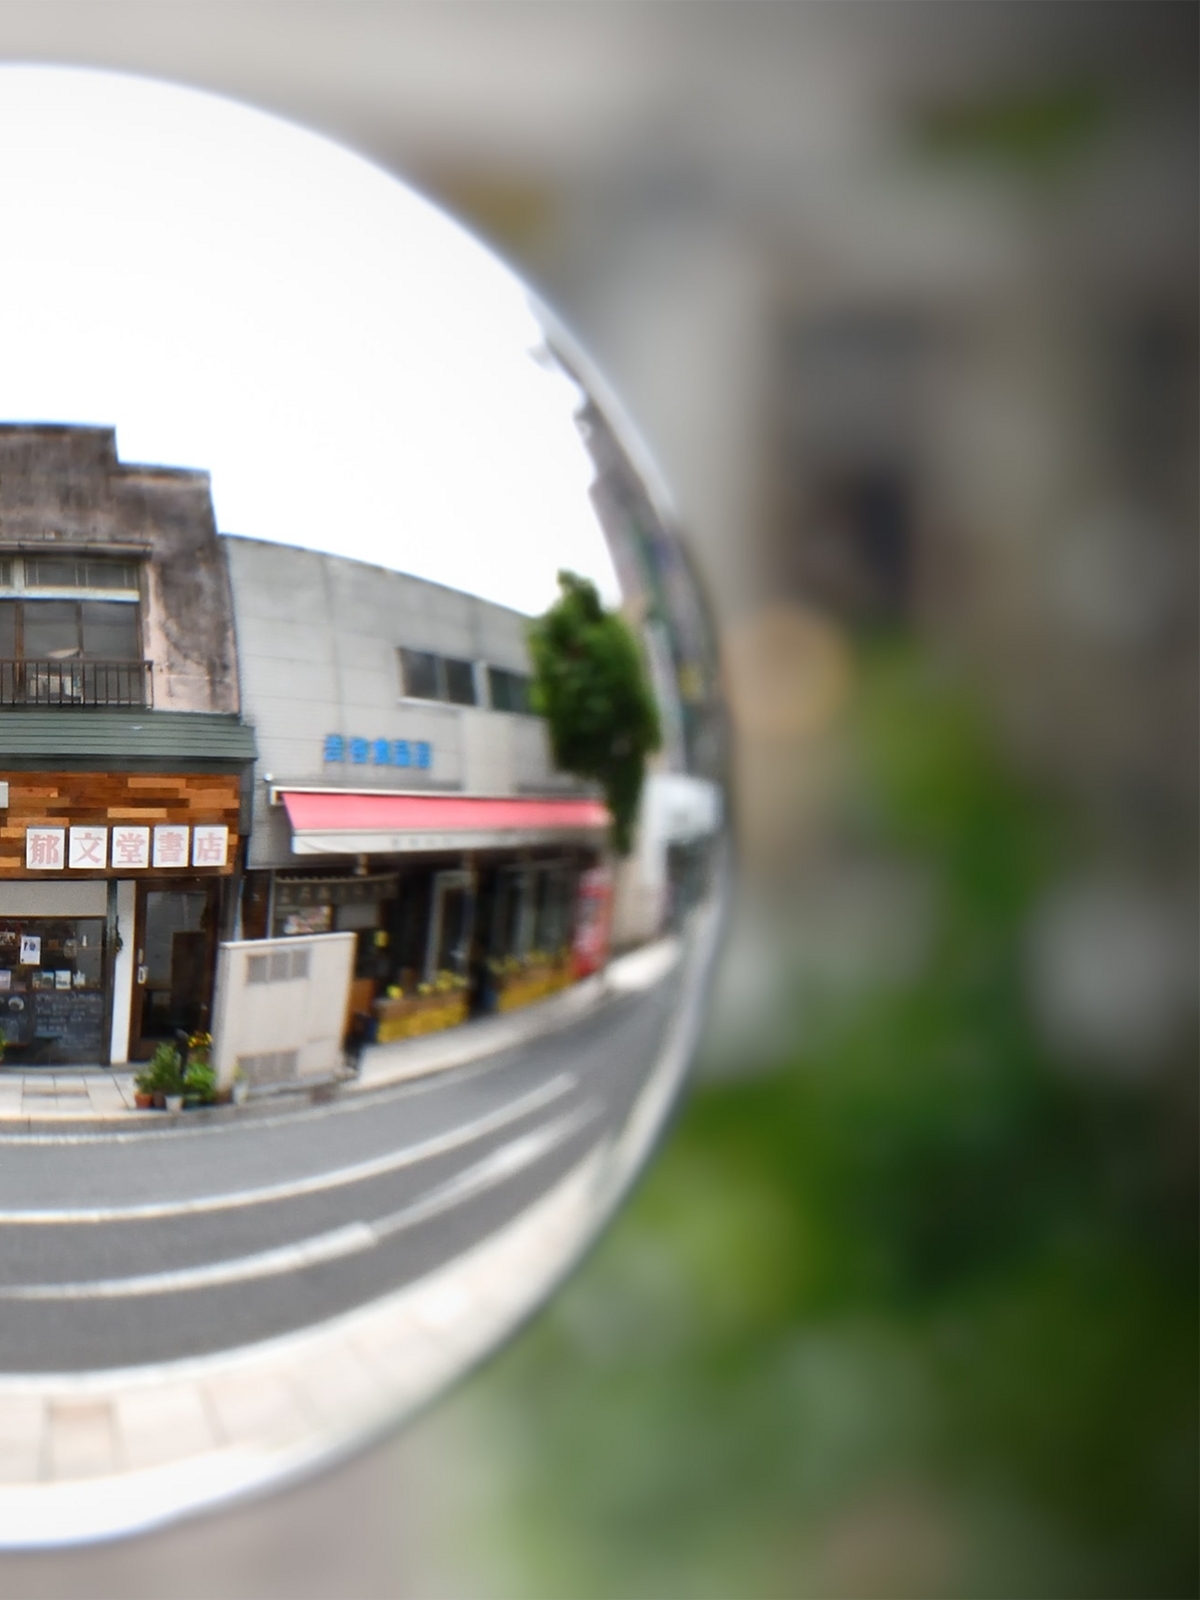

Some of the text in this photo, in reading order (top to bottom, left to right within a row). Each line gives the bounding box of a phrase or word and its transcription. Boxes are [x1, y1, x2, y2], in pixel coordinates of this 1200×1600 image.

[29, 831, 224, 866] 郁文堂書店
